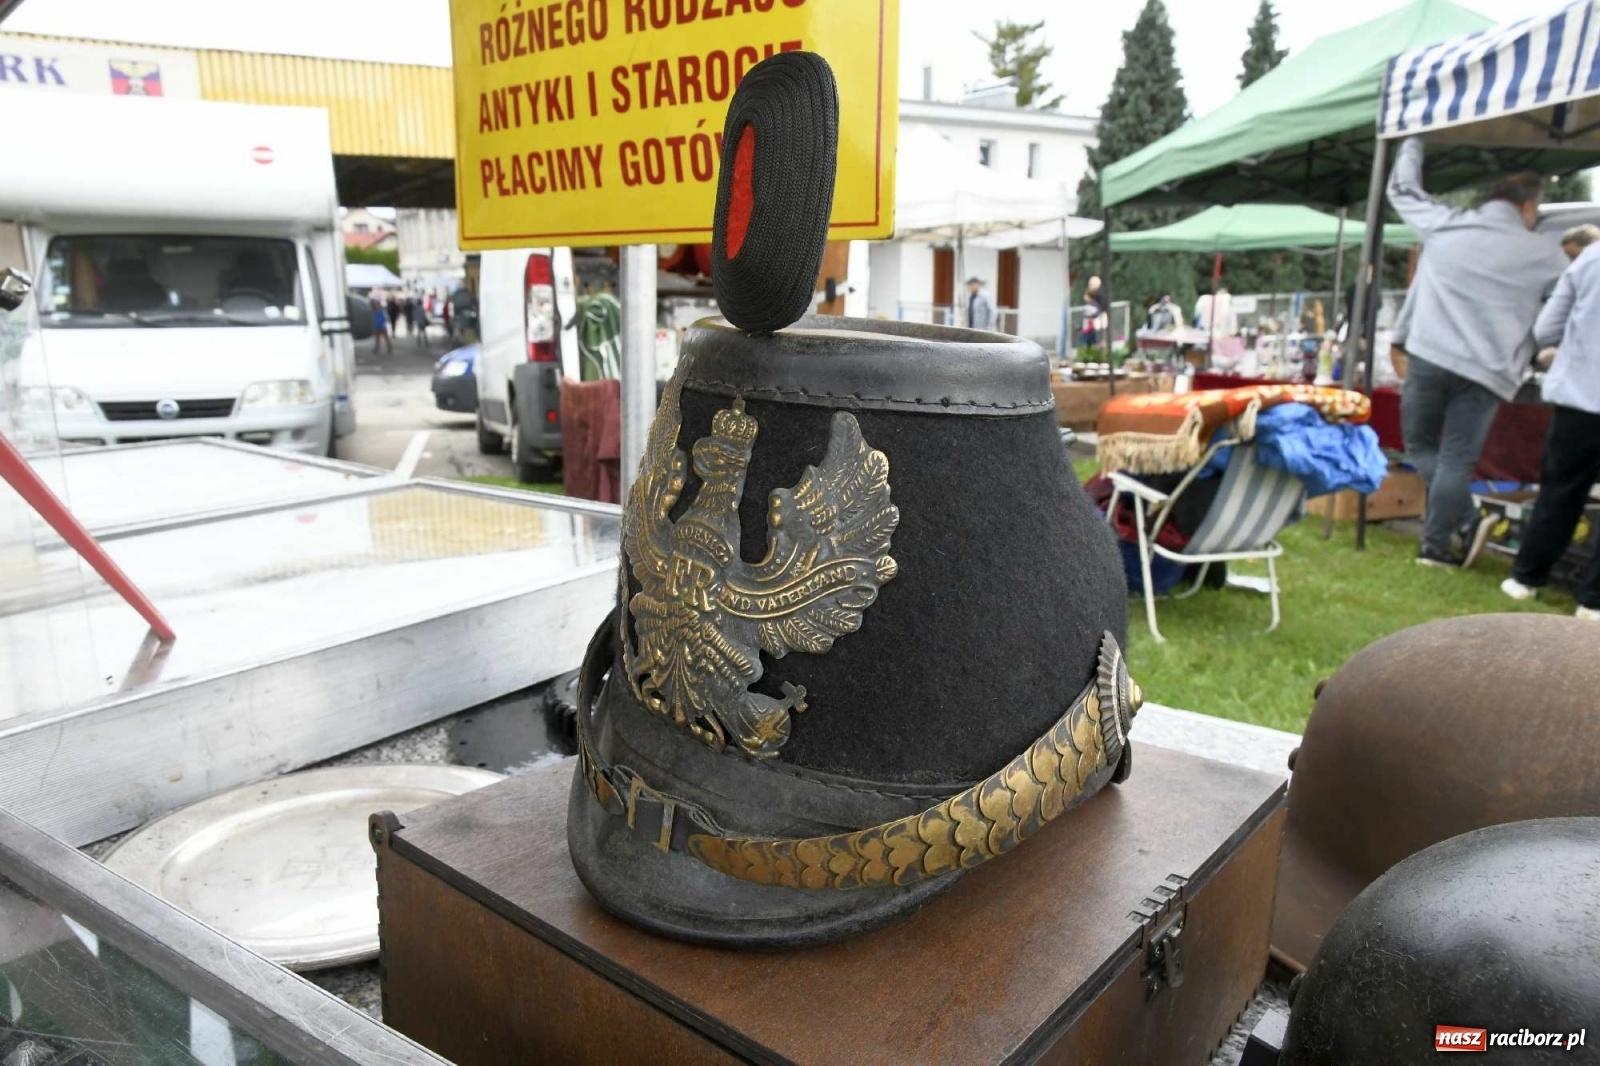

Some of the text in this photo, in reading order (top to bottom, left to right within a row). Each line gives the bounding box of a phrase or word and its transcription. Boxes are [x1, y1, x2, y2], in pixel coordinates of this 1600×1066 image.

[479, 0, 608, 66] RÓŻNEGO
[479, 40, 803, 134] ANTYKI I STAROC
[480, 144, 603, 198] PŁACIMY
[755, 565, 857, 611] VATERLAND
